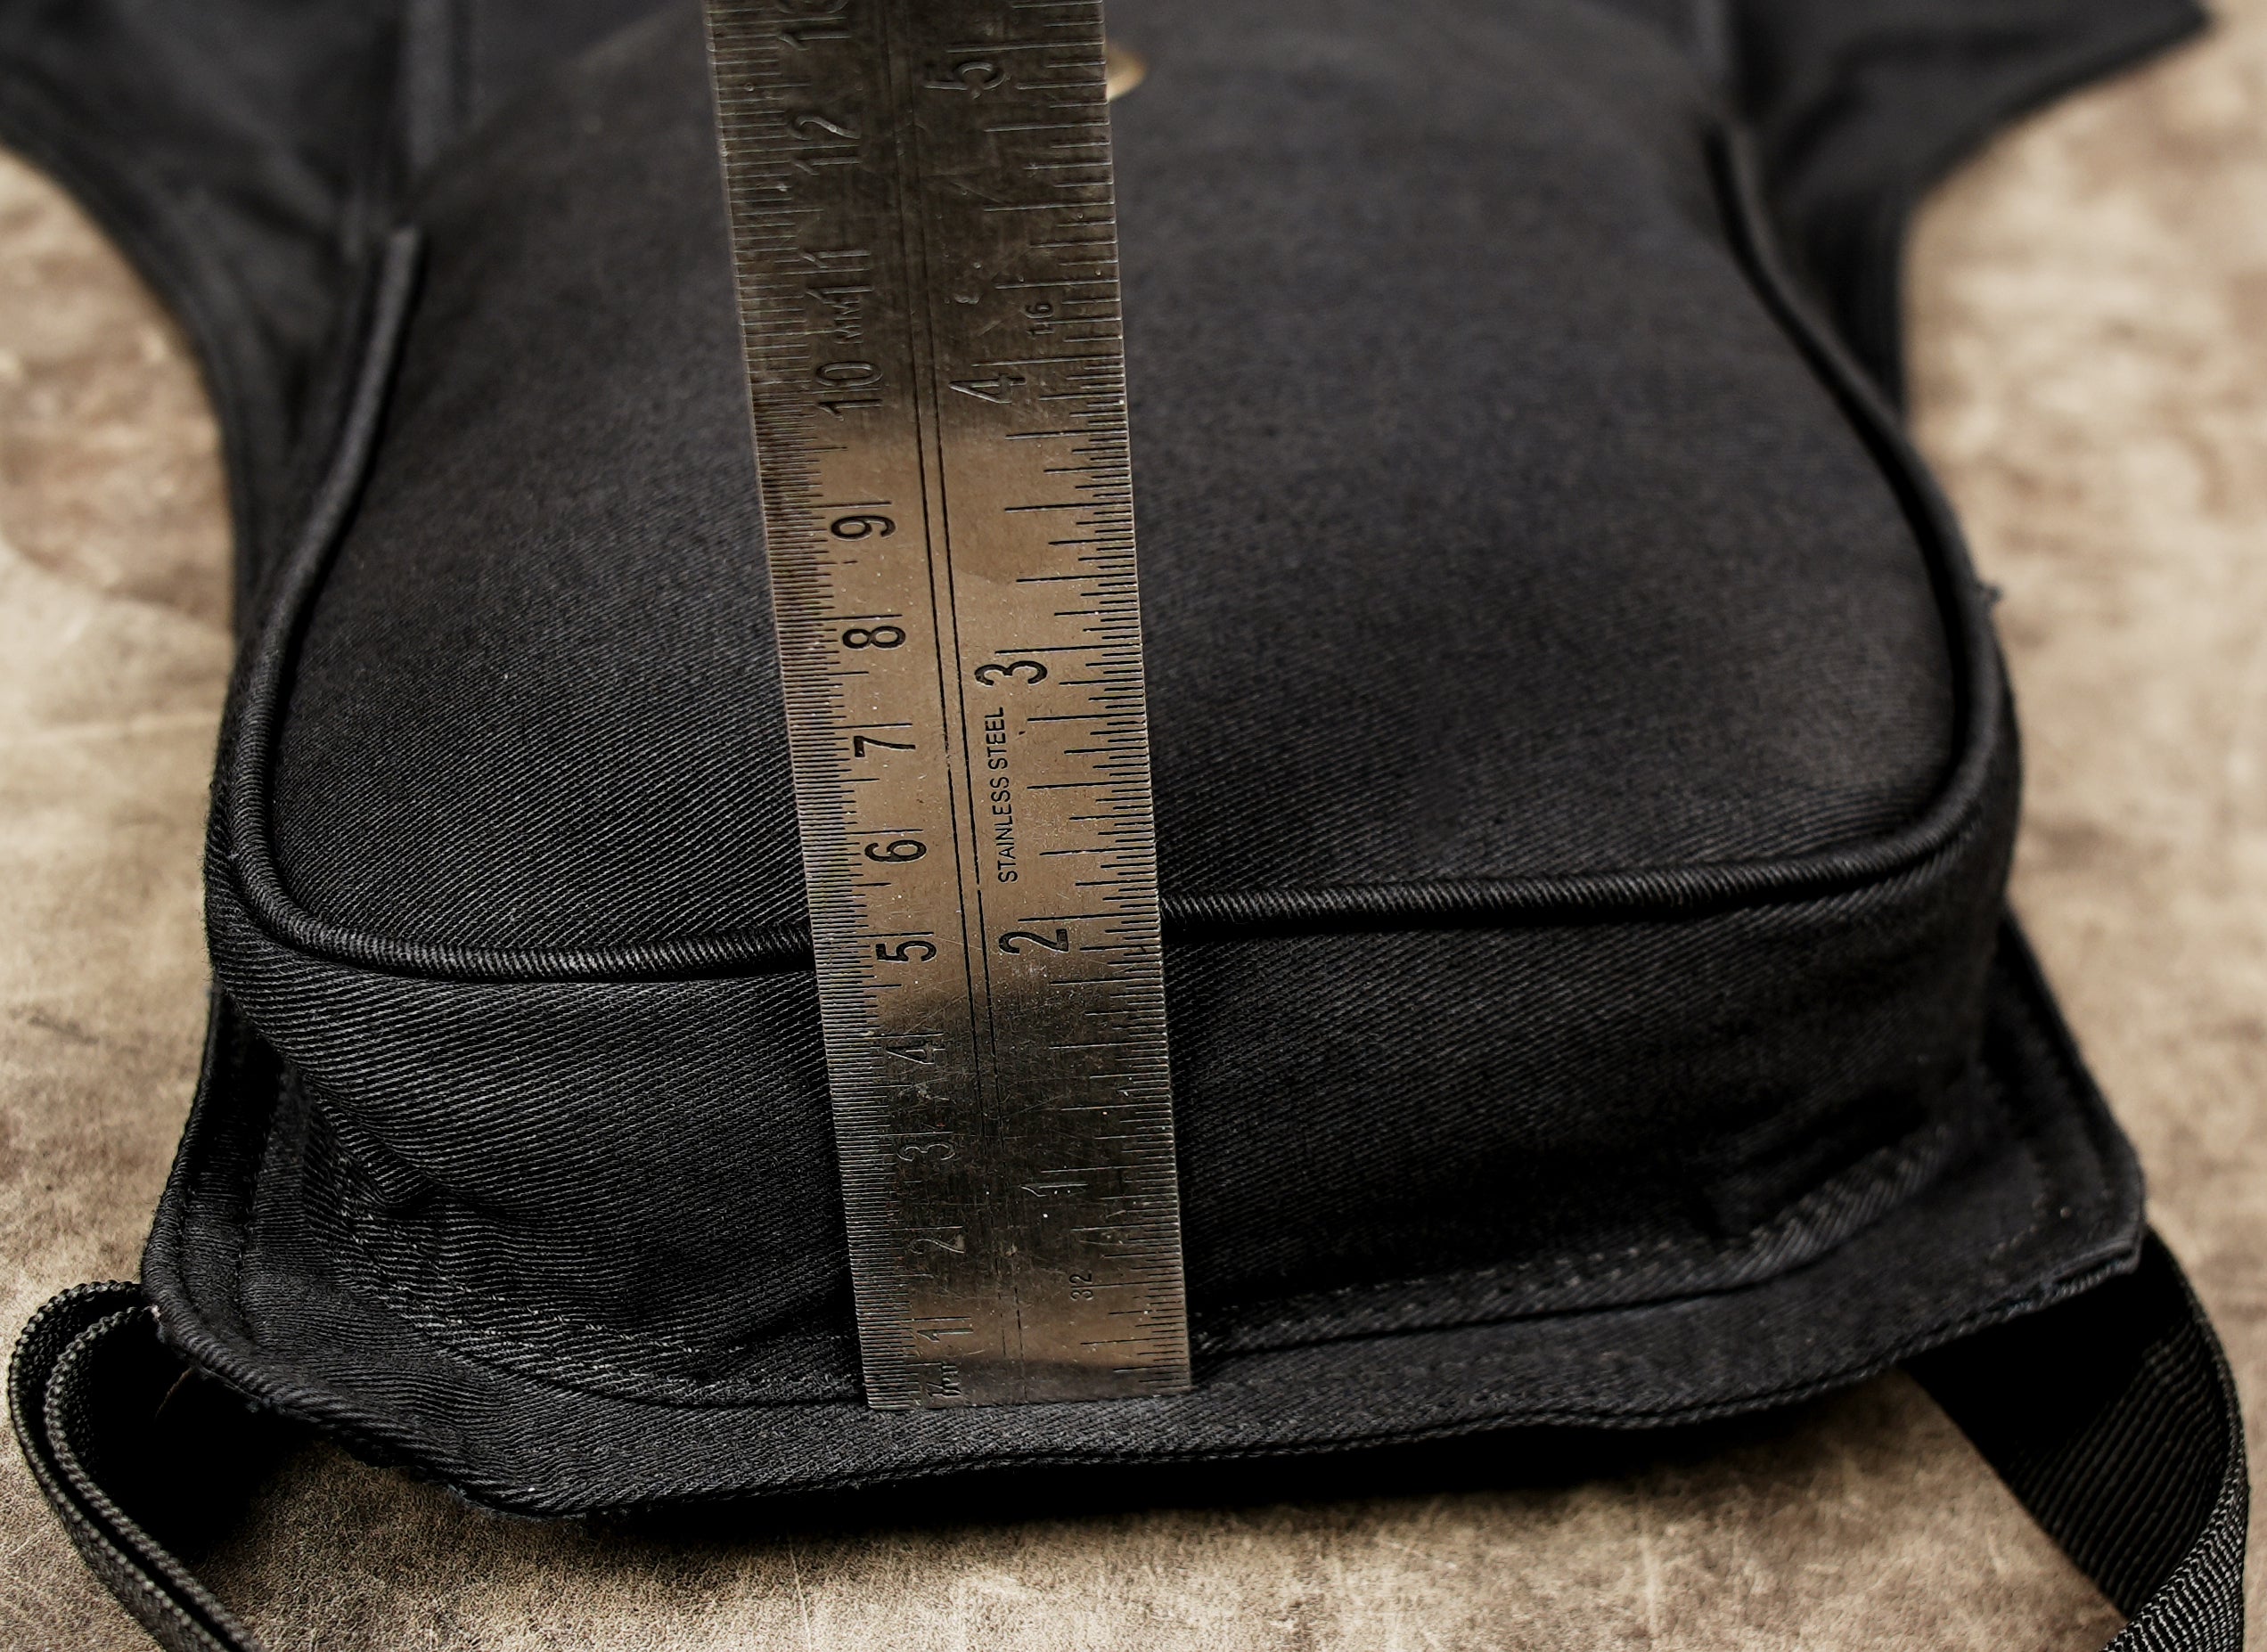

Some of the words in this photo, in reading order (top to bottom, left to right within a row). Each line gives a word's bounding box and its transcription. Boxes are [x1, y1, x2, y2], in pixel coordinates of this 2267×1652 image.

[923, 62, 1008, 100] 5
[784, 113, 862, 176] 12
[801, 248, 874, 304] 11
[1025, 301, 1056, 339] 16
[814, 360, 883, 421] 10
[948, 374, 1027, 404] 4
[831, 514, 896, 542] 9
[842, 626, 906, 650] 8
[975, 659, 1048, 687] 3
[854, 735, 916, 758] 7
[986, 707, 1009, 771] STEEL
[990, 777, 1019, 884] STAINLESS
[864, 839, 927, 863] 6
[875, 939, 937, 963] 5
[998, 927, 1069, 954] 2
[886, 1044, 946, 1065] 4
[896, 1141, 956, 1162] 3
[909, 1233, 965, 1255] 2
[1069, 1272, 1093, 1303] 32
[918, 1328, 974, 1343] 1
